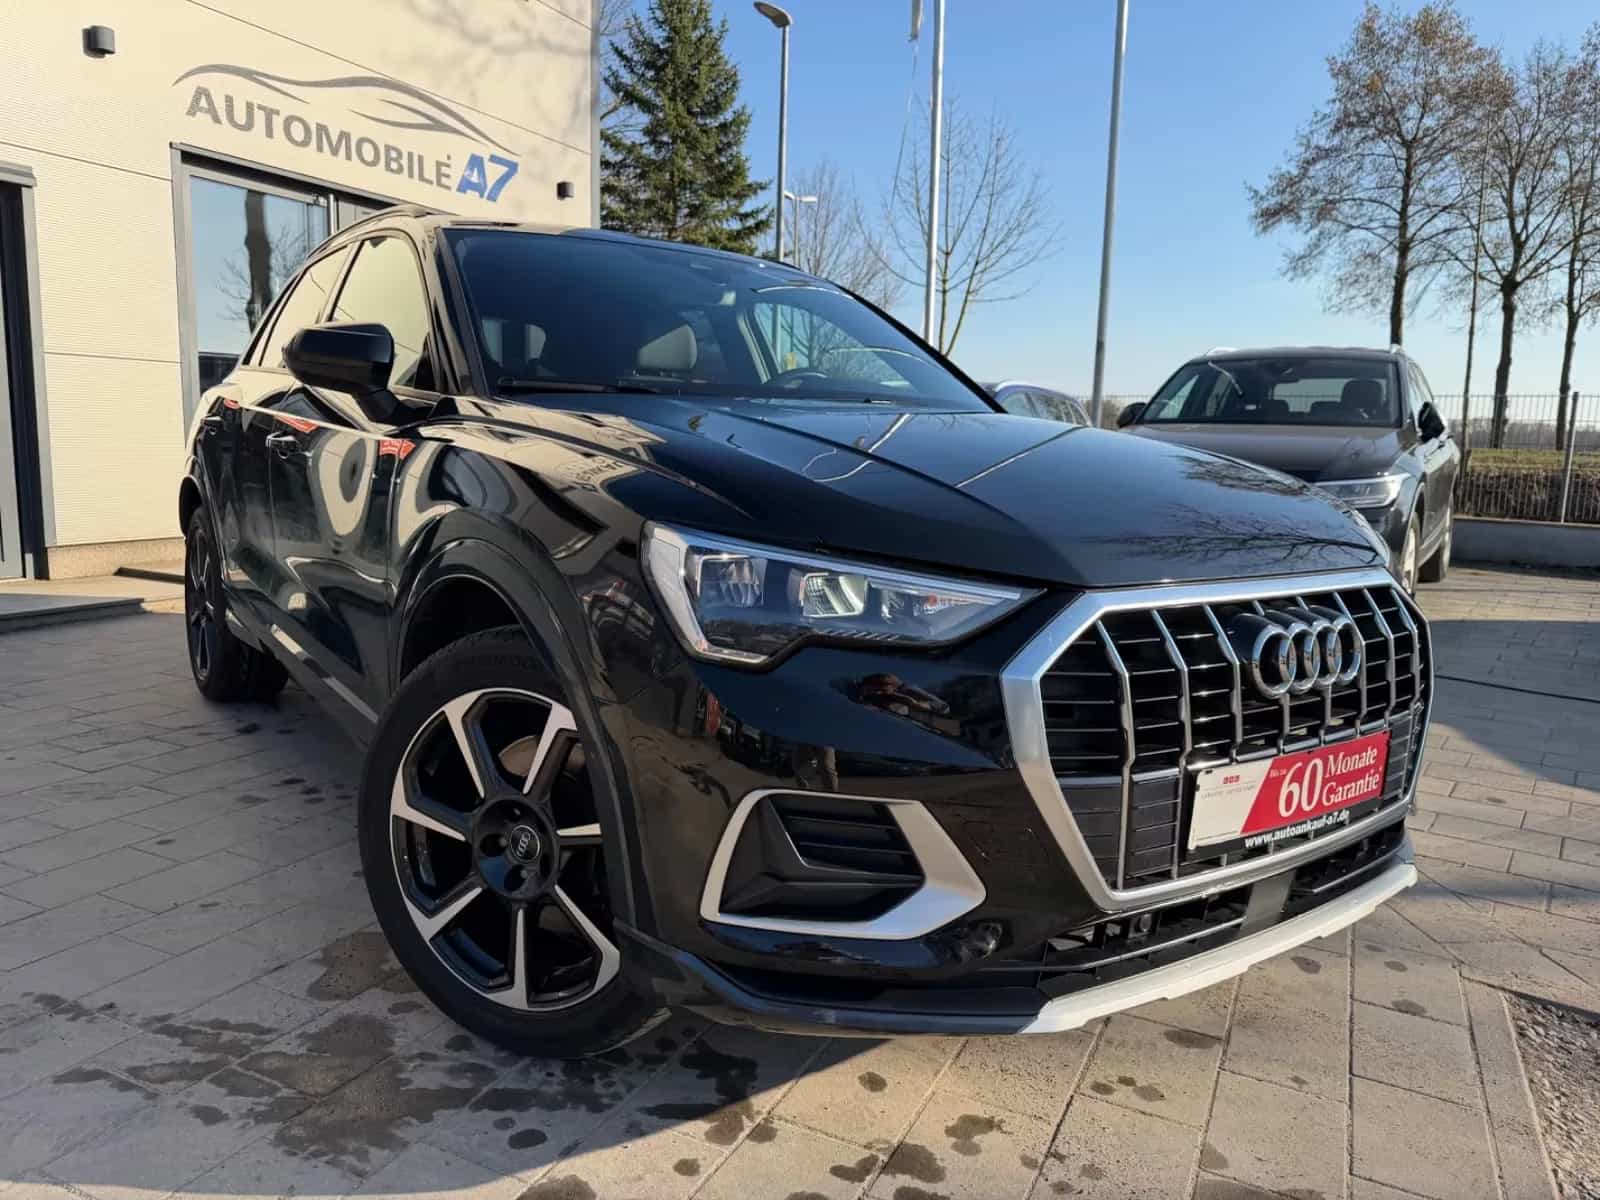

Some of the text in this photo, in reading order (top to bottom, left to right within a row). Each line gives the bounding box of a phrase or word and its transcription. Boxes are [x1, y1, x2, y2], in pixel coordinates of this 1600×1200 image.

[185, 85, 519, 203] AUTOMOBILE A7
[1325, 746, 1378, 778] Monate
[1278, 758, 1324, 818] 60
[1322, 769, 1380, 806] Garantie
